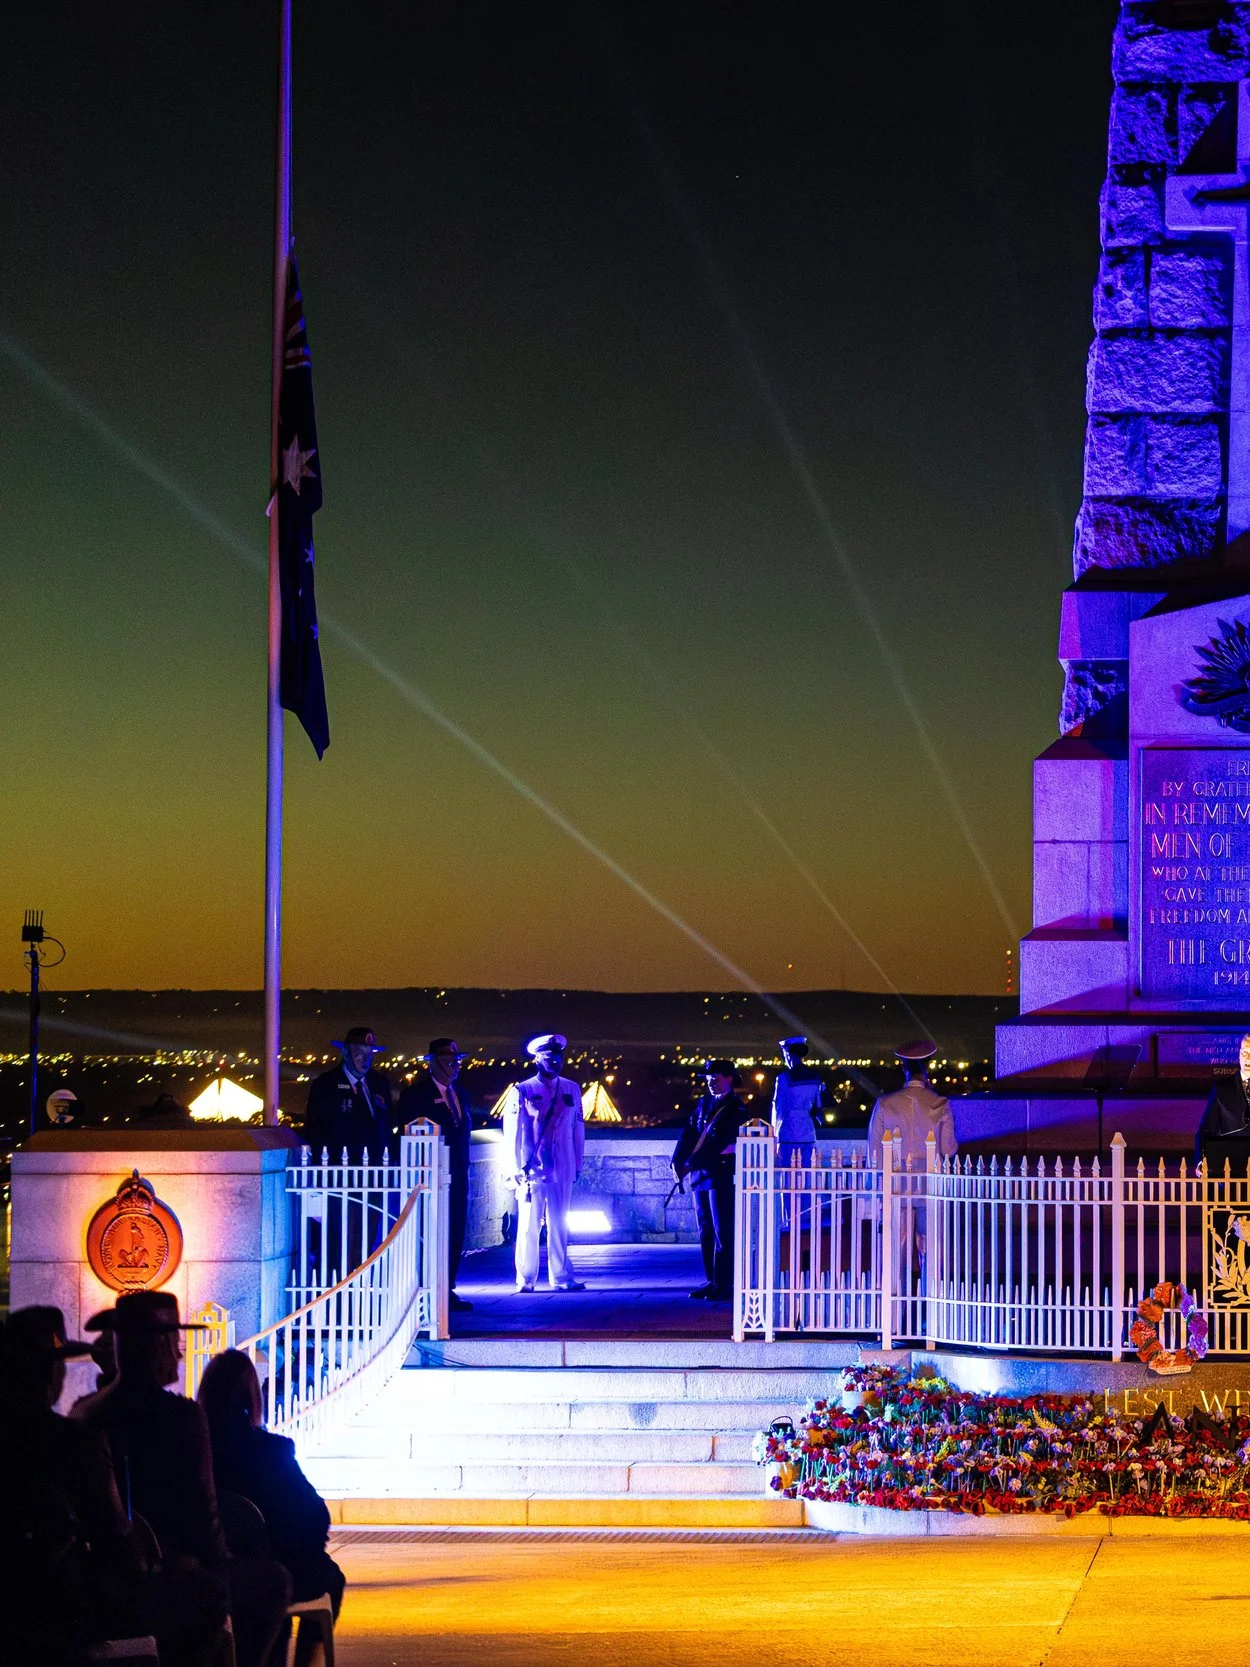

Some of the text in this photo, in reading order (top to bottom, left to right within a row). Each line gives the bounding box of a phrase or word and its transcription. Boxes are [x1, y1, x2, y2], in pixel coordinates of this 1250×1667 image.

[1162, 782, 1184, 797] BY
[1145, 803, 1166, 825] IN
[1151, 832, 1200, 859] MEN
[1209, 832, 1238, 859] OF
[1152, 866, 1188, 882] WHO
[1194, 866, 1212, 882] AT
[1219, 866, 1249, 882] THE
[1164, 887, 1207, 903] GAVE
[1150, 909, 1230, 924] FREEDOM
[1167, 939, 1211, 965] THE
[1213, 971, 1250, 986] 1914
[1104, 1387, 1183, 1416] LEST
